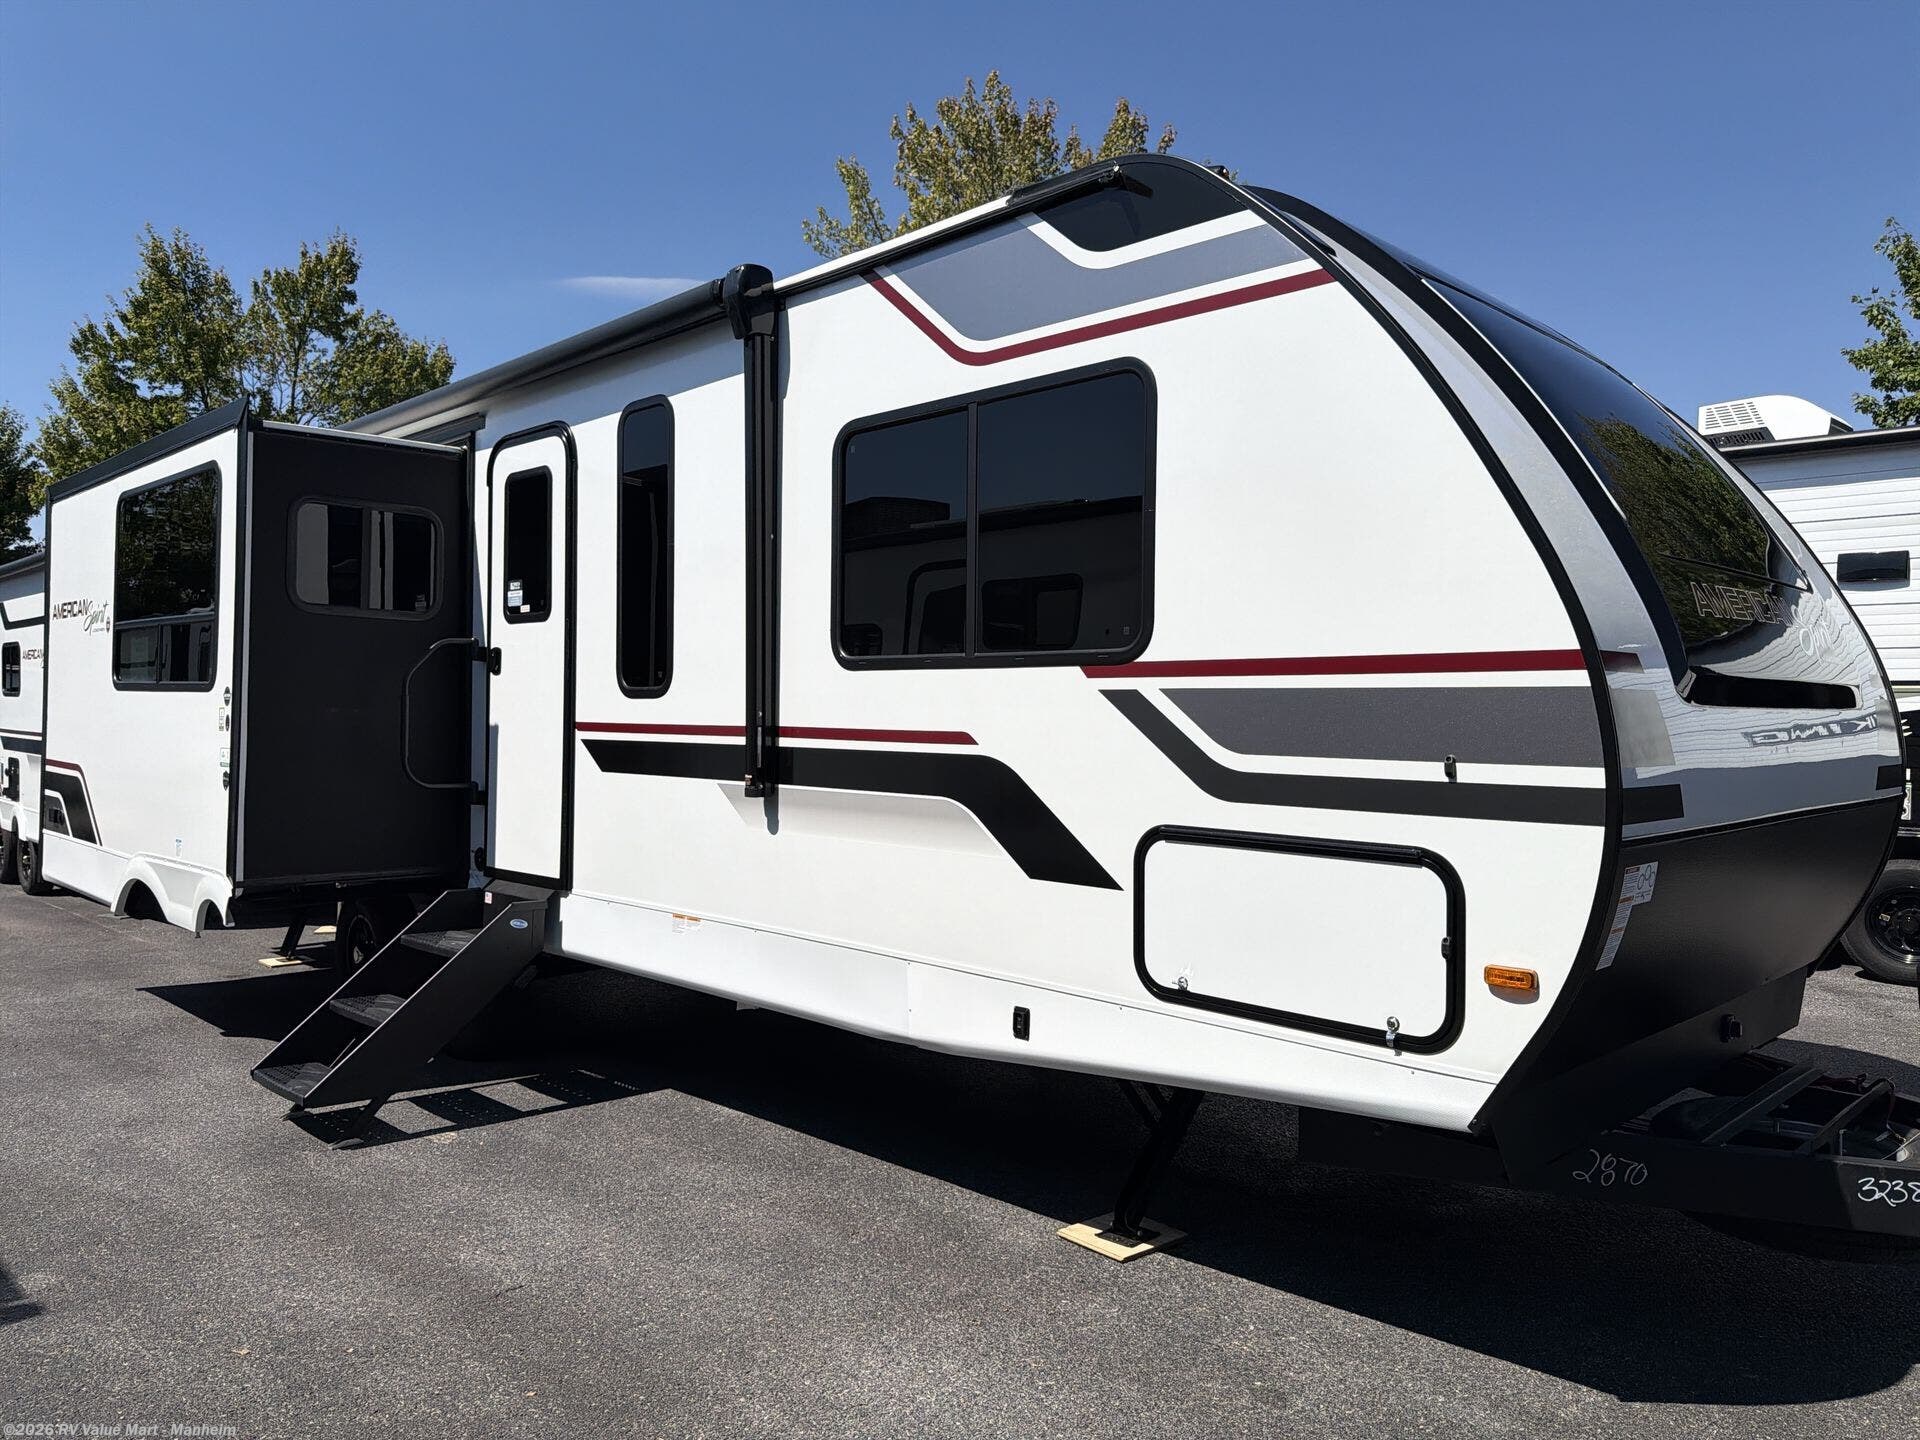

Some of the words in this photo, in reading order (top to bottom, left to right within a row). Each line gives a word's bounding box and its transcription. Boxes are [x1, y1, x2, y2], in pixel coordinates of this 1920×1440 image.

[52, 598, 88, 620] AMERICAN
[83, 600, 110, 637] Spirit
[1690, 581, 1793, 626] AMERICAN
[1572, 1149, 1648, 1186] 2870
